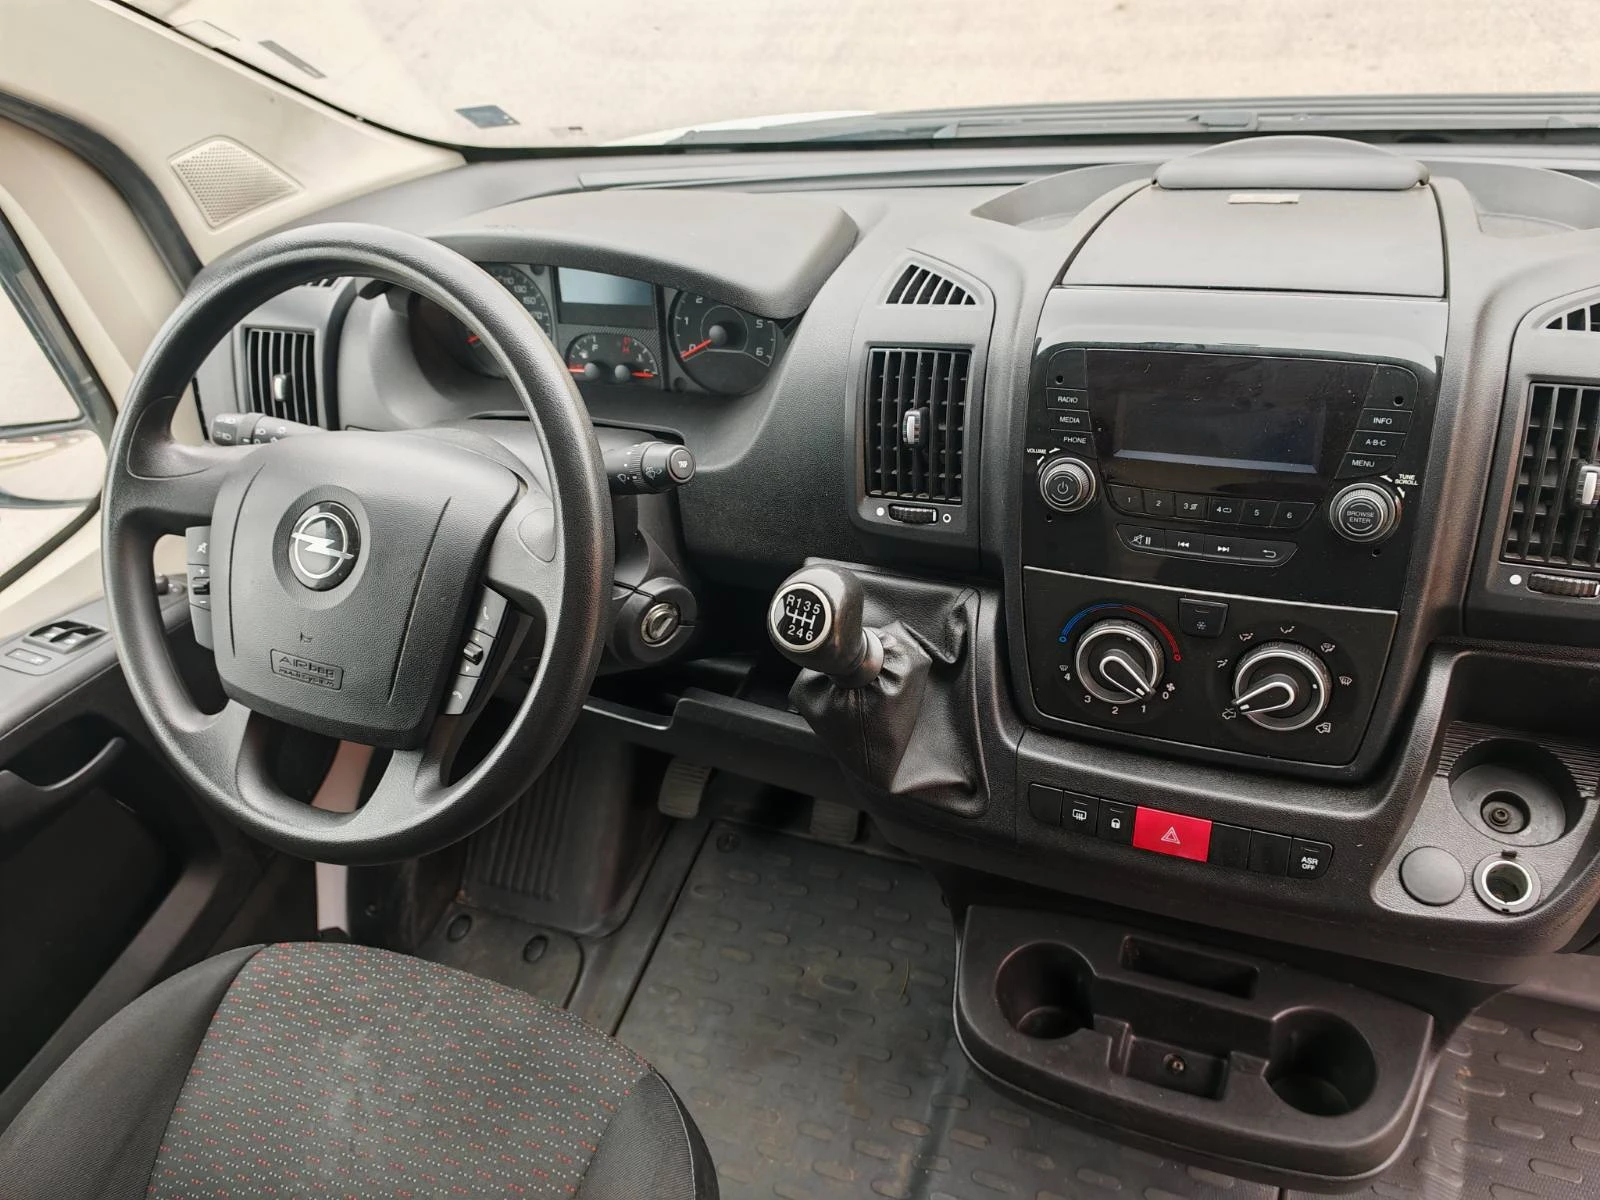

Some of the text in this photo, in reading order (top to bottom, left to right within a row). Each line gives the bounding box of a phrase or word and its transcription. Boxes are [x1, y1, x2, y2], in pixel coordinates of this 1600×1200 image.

[756, 319, 764, 329] 5
[755, 347, 764, 357] 6
[1057, 395, 1079, 404] RADIO
[1059, 416, 1081, 424] MEDIA
[1373, 417, 1393, 425] INFO
[1063, 436, 1087, 444] PHONE
[1351, 459, 1376, 468] MENU
[1399, 473, 1416, 481] TUNE
[1394, 478, 1419, 486] SCROLL
[1155, 500, 1162, 508] 2
[1183, 502, 1190, 510] 3
[1216, 506, 1223, 514] 4
[1254, 508, 1261, 517] 5
[1346, 510, 1375, 518] BROWSE
[1286, 511, 1294, 520] 6
[1349, 516, 1371, 524] ENTER
[1064, 672, 1071, 681] 4
[1084, 695, 1092, 704] 3
[1111, 706, 1119, 714] 2
[1141, 704, 1147, 713] 1
[1301, 856, 1319, 866] ASR
